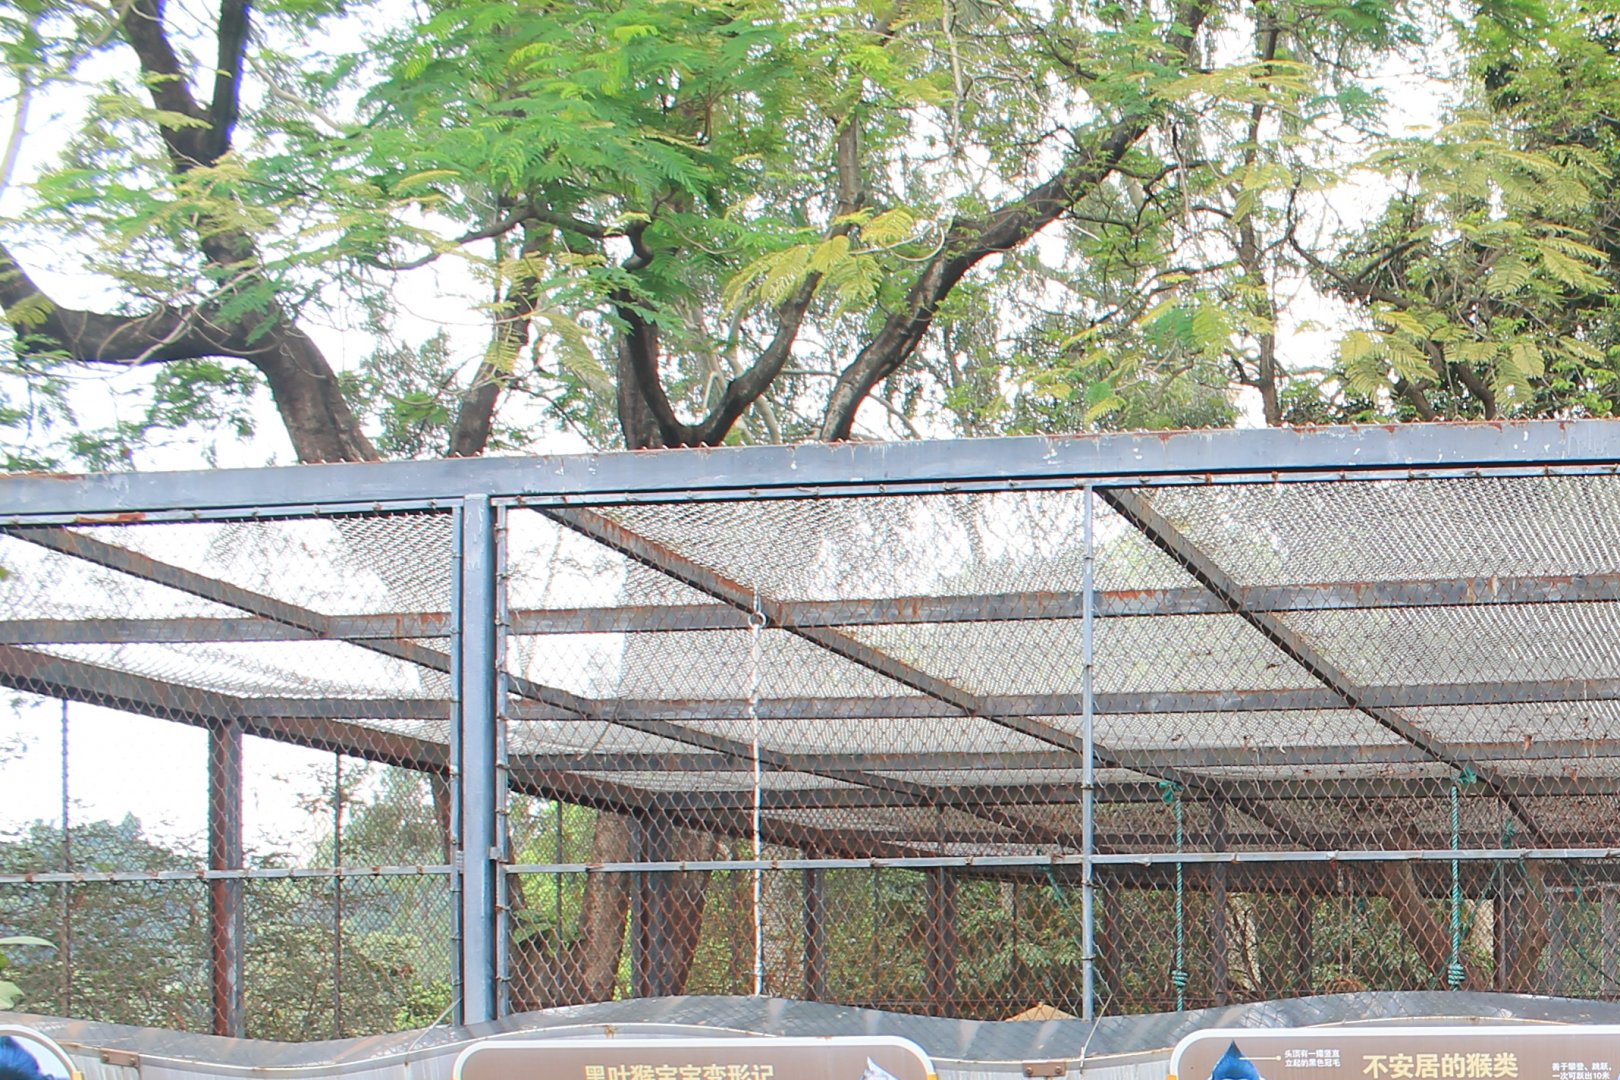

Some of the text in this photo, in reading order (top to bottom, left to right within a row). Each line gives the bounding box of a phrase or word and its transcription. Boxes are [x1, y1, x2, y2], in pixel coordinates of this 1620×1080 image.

[1362, 1052, 1519, 1079] 不安居的猴类
